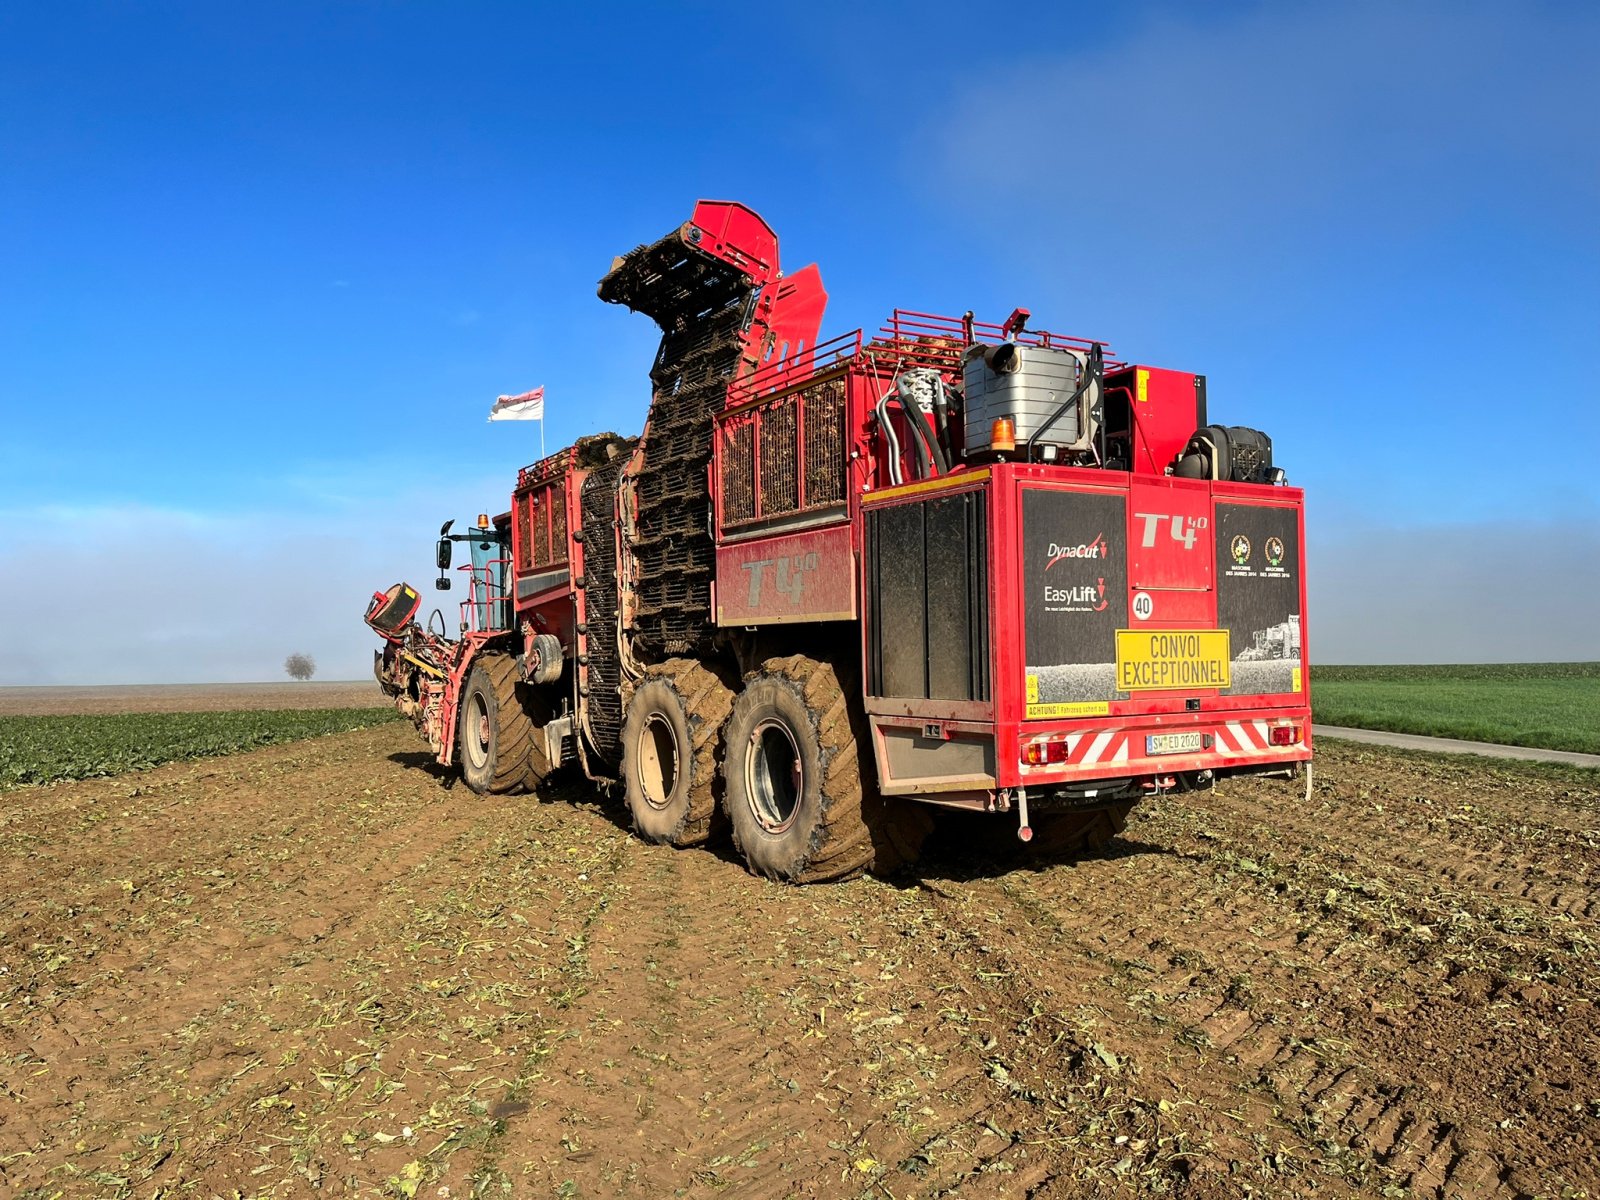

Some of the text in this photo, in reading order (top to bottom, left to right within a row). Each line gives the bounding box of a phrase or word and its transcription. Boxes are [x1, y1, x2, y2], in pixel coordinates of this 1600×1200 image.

[1047, 543, 1100, 560] DynaCut
[1044, 586, 1097, 606] EasyLift
[1135, 597, 1150, 614] 40
[1150, 635, 1200, 658] CONVOI
[1123, 660, 1225, 686] EXCEPTIONNEL
[1180, 734, 1199, 747] 2020
